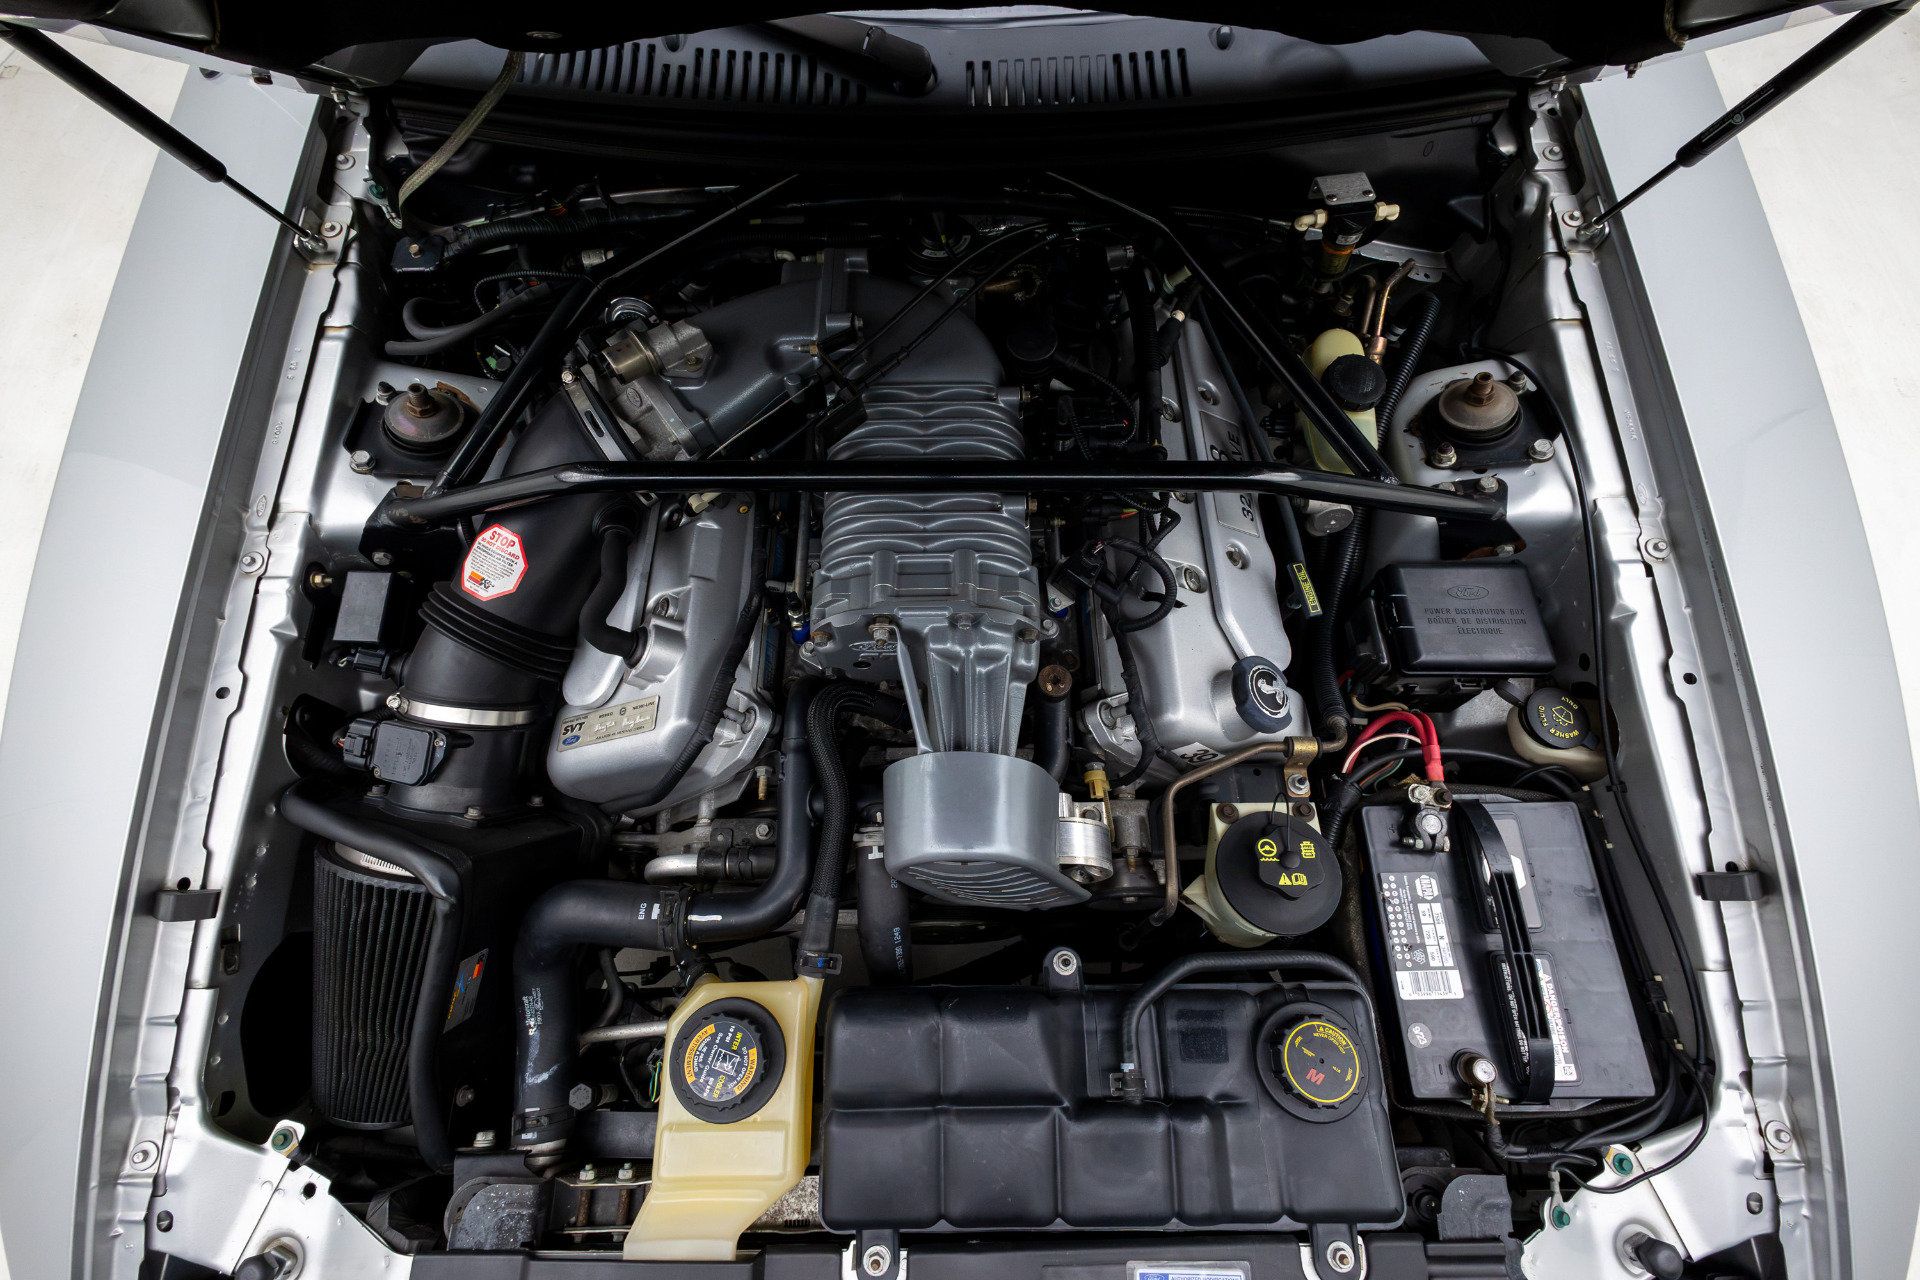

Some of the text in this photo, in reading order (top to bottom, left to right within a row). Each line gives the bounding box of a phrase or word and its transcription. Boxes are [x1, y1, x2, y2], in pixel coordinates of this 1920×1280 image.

[490, 530, 516, 548] STOP
[496, 545, 520, 560] DISCARD
[1297, 568, 1316, 606] ENGINE OIL
[1510, 608, 1527, 616] BOX
[1538, 696, 1580, 739] WASHER FLUID ONLY
[562, 721, 586, 736] SVT
[638, 902, 647, 920] ENG
[1324, 1027, 1346, 1045] CAUTION
[1412, 1026, 1428, 1044] 9/23
[687, 1029, 708, 1078] AVERTISSEMENT
[699, 1032, 723, 1082] See Owner Guide
[711, 1031, 742, 1098] INTER COOLER
[736, 1067, 746, 1080] OPEN
[727, 1080, 737, 1088] HOT
[737, 1059, 754, 1091] WARNING
